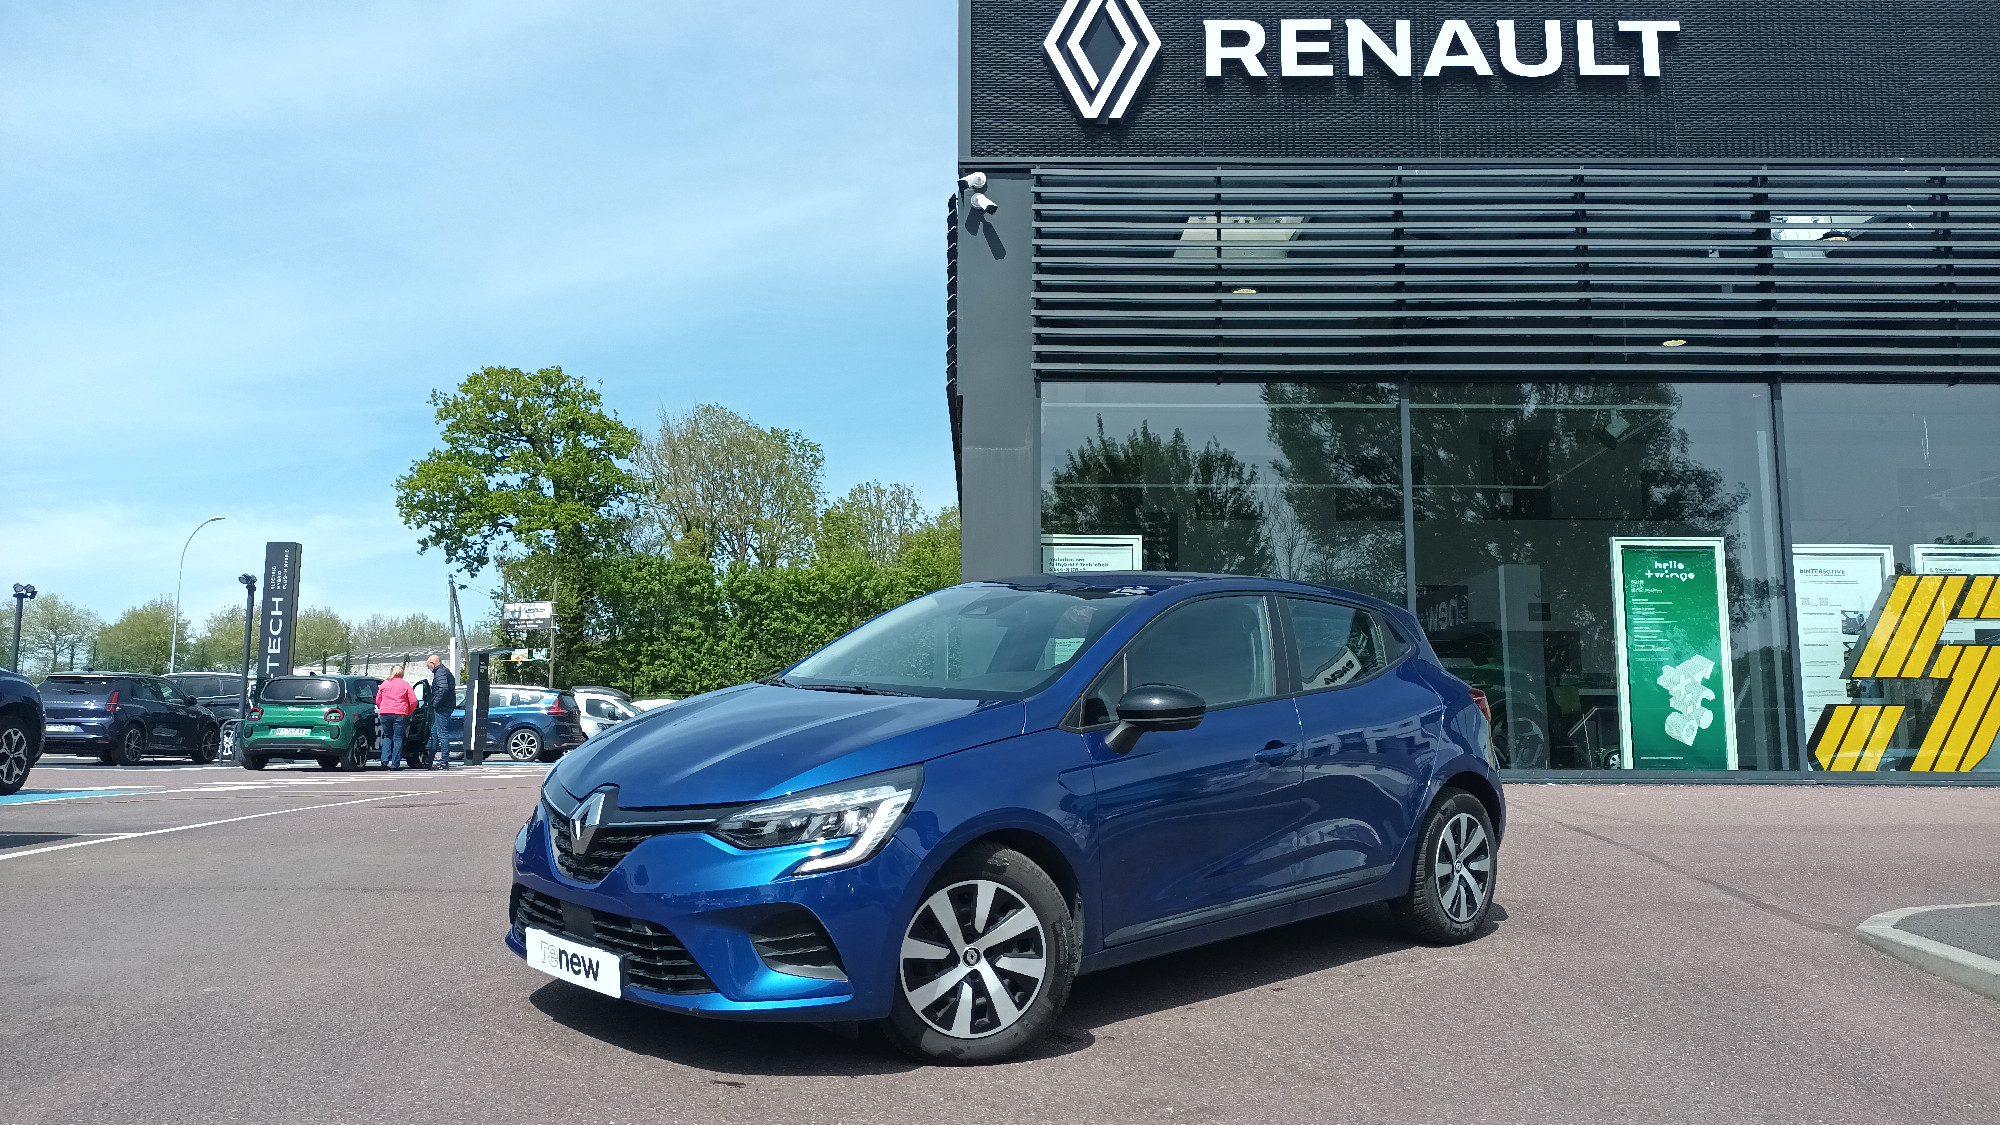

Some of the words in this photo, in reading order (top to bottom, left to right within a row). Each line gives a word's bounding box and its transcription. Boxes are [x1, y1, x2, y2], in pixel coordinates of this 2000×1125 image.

[1203, 18, 1681, 77] RENAULT
[1654, 560, 1685, 570] hello
[266, 597, 284, 679] -TECH
